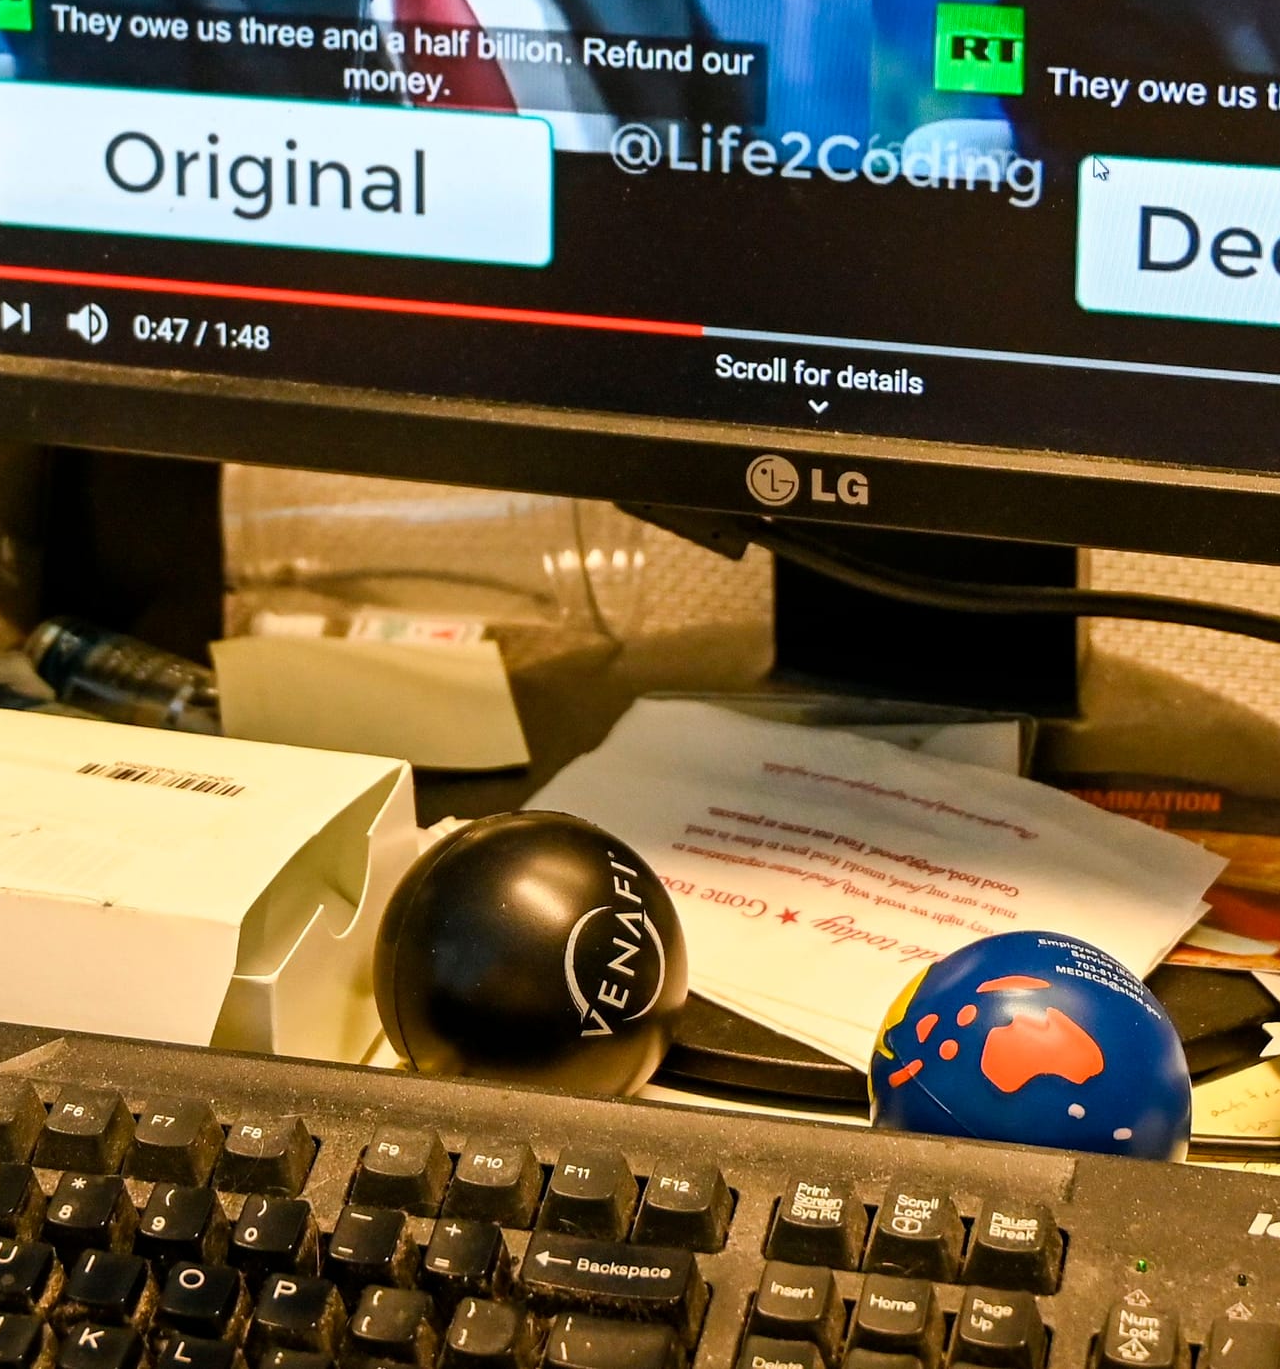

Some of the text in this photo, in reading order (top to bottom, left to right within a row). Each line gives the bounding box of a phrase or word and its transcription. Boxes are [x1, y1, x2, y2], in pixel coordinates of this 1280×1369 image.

[51, 4, 754, 76] They owe us three and a half billion. Refund our
[343, 68, 451, 101] money.
[1047, 66, 1128, 108] They
[1138, 79, 1206, 106] owe
[1218, 84, 1257, 110] us
[104, 129, 428, 223] Original
[610, 122, 1043, 208] @Life2Coding
[132, 312, 191, 343] 0:47
[215, 319, 271, 350] 1:48
[715, 354, 924, 394] Scroll for details
[811, 468, 869, 506] LG
[699, 886, 900, 955] today Gone
[581, 861, 646, 1037] VENAFI
[63, 1104, 84, 1117] F6
[151, 1114, 176, 1127] F7
[241, 1125, 262, 1139] F8
[378, 1142, 400, 1157] F9
[473, 1154, 503, 1169] F10
[564, 1164, 591, 1181] F11
[659, 1176, 690, 1193] F12
[576, 1257, 672, 1280] Backspace
[771, 1281, 814, 1300] Insert
[870, 1293, 917, 1312] Home
[972, 1299, 1013, 1320] Page
[1121, 1310, 1159, 1328] Num
